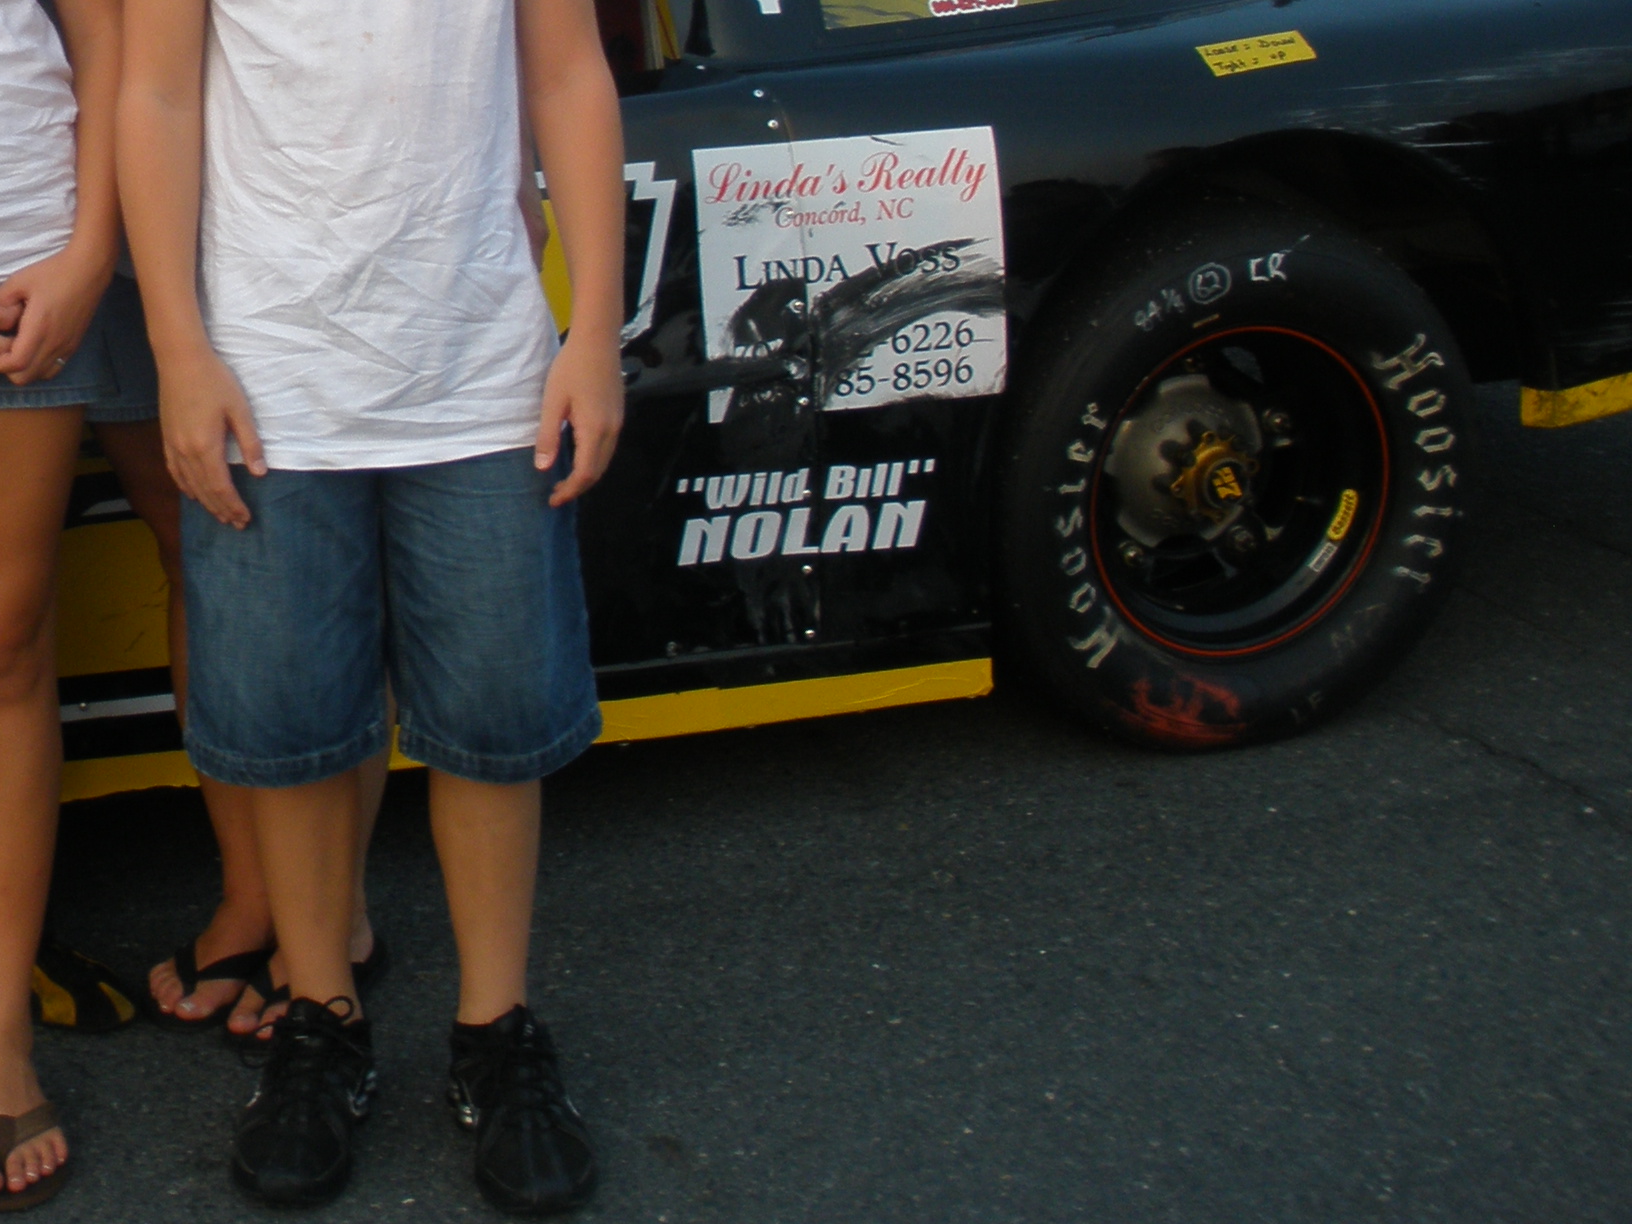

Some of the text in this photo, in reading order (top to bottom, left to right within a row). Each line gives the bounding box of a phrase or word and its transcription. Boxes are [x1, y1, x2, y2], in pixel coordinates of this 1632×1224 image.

[705, 147, 989, 204] Linda's Realty
[775, 198, 915, 229] Concord, NC
[733, 255, 850, 291] LINDA
[677, 500, 927, 566] NOLAN
